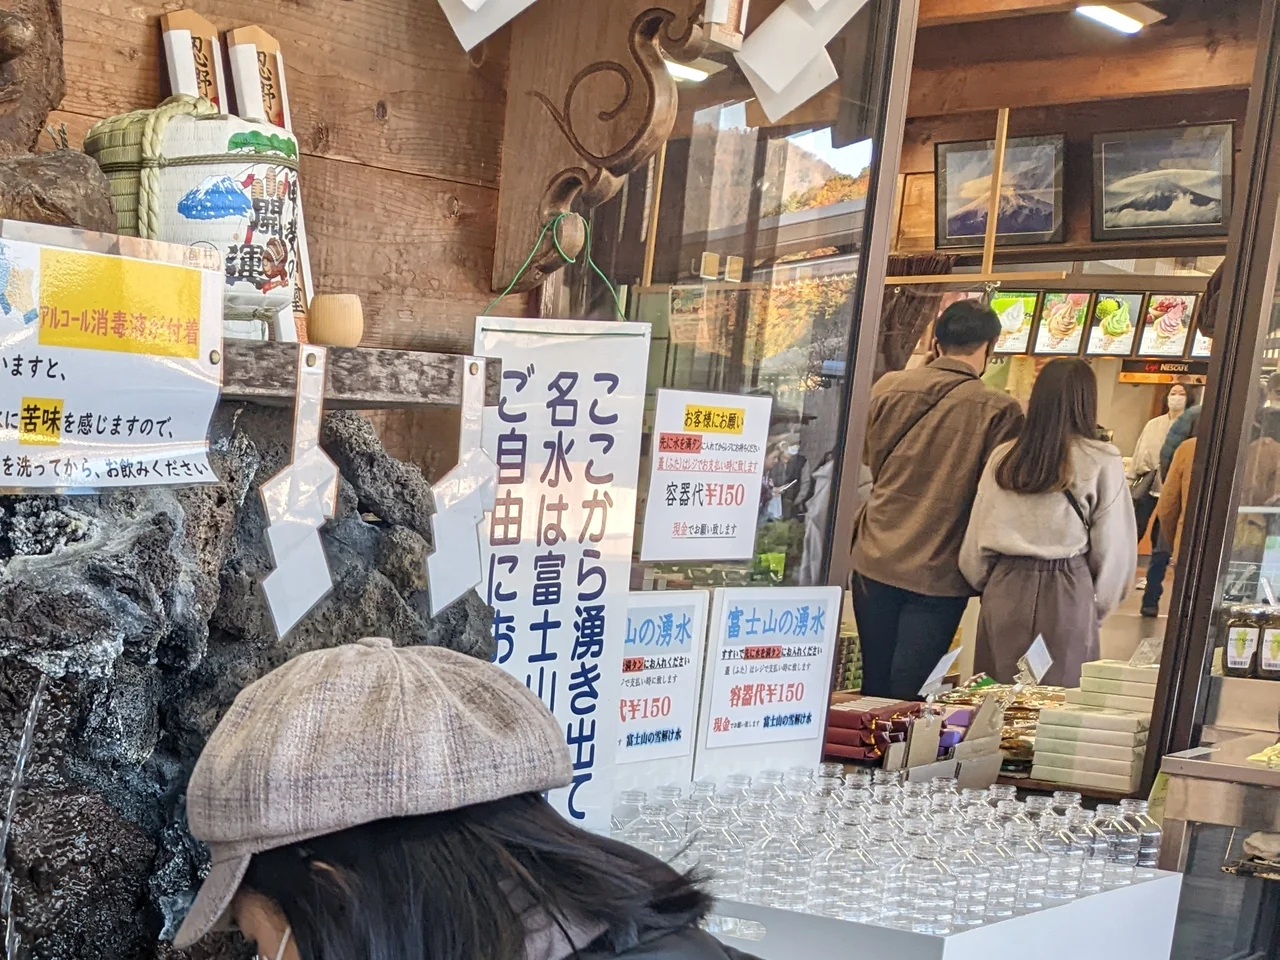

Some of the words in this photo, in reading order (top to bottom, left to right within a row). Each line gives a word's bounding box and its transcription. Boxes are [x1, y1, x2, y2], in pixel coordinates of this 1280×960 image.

[684, 409, 744, 430] お客様にお願い
[567, 373, 619, 820] ここから湧き出て
[728, 605, 825, 639] 富士山の湧水
[623, 656, 690, 671] 満タンにお入れください
